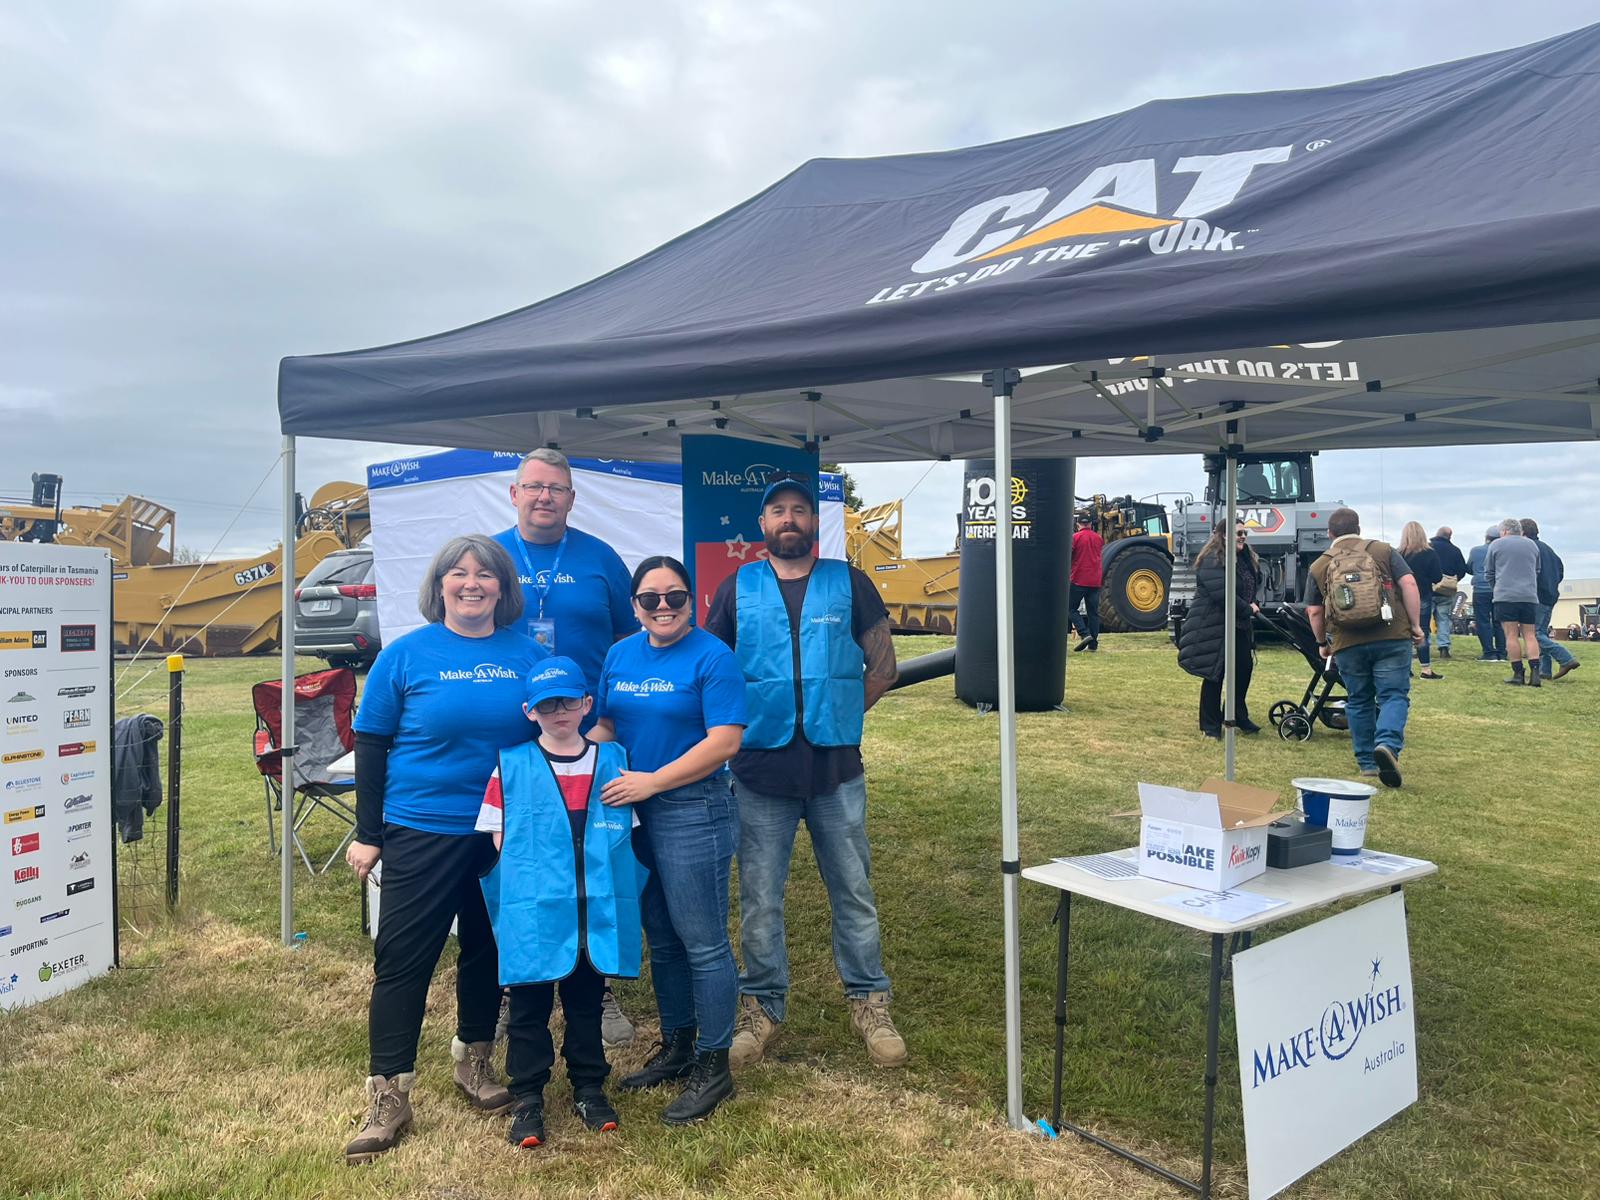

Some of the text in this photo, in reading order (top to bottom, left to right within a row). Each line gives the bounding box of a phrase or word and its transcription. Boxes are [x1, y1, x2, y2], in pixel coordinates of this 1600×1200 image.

[911, 144, 1293, 274] CAT
[865, 272, 968, 305] LET'S
[964, 256, 1024, 284] DO
[1027, 241, 1110, 265] THE
[967, 505, 1027, 520] YEAS
[965, 525, 1029, 539] CATERPAR
[12, 563, 19, 572] of
[21, 563, 58, 575] Caterpillar
[59, 565, 66, 574] in
[67, 565, 99, 575] Tasmania
[234, 563, 270, 586] 637K
[27, 576, 37, 585] TO
[38, 576, 54, 586] OUR
[21, 607, 54, 615] PARTNERS
[33, 634, 46, 645] CAT
[4, 668, 38, 678] SPONSORS
[6, 714, 39, 725] UNITED
[1147, 849, 1215, 871] POSSIBLE
[1182, 843, 1216, 861] AKE
[10, 937, 49, 957] SUPPORTING
[52, 954, 85, 973] EXETER
[1363, 1040, 1406, 1075] Australia
